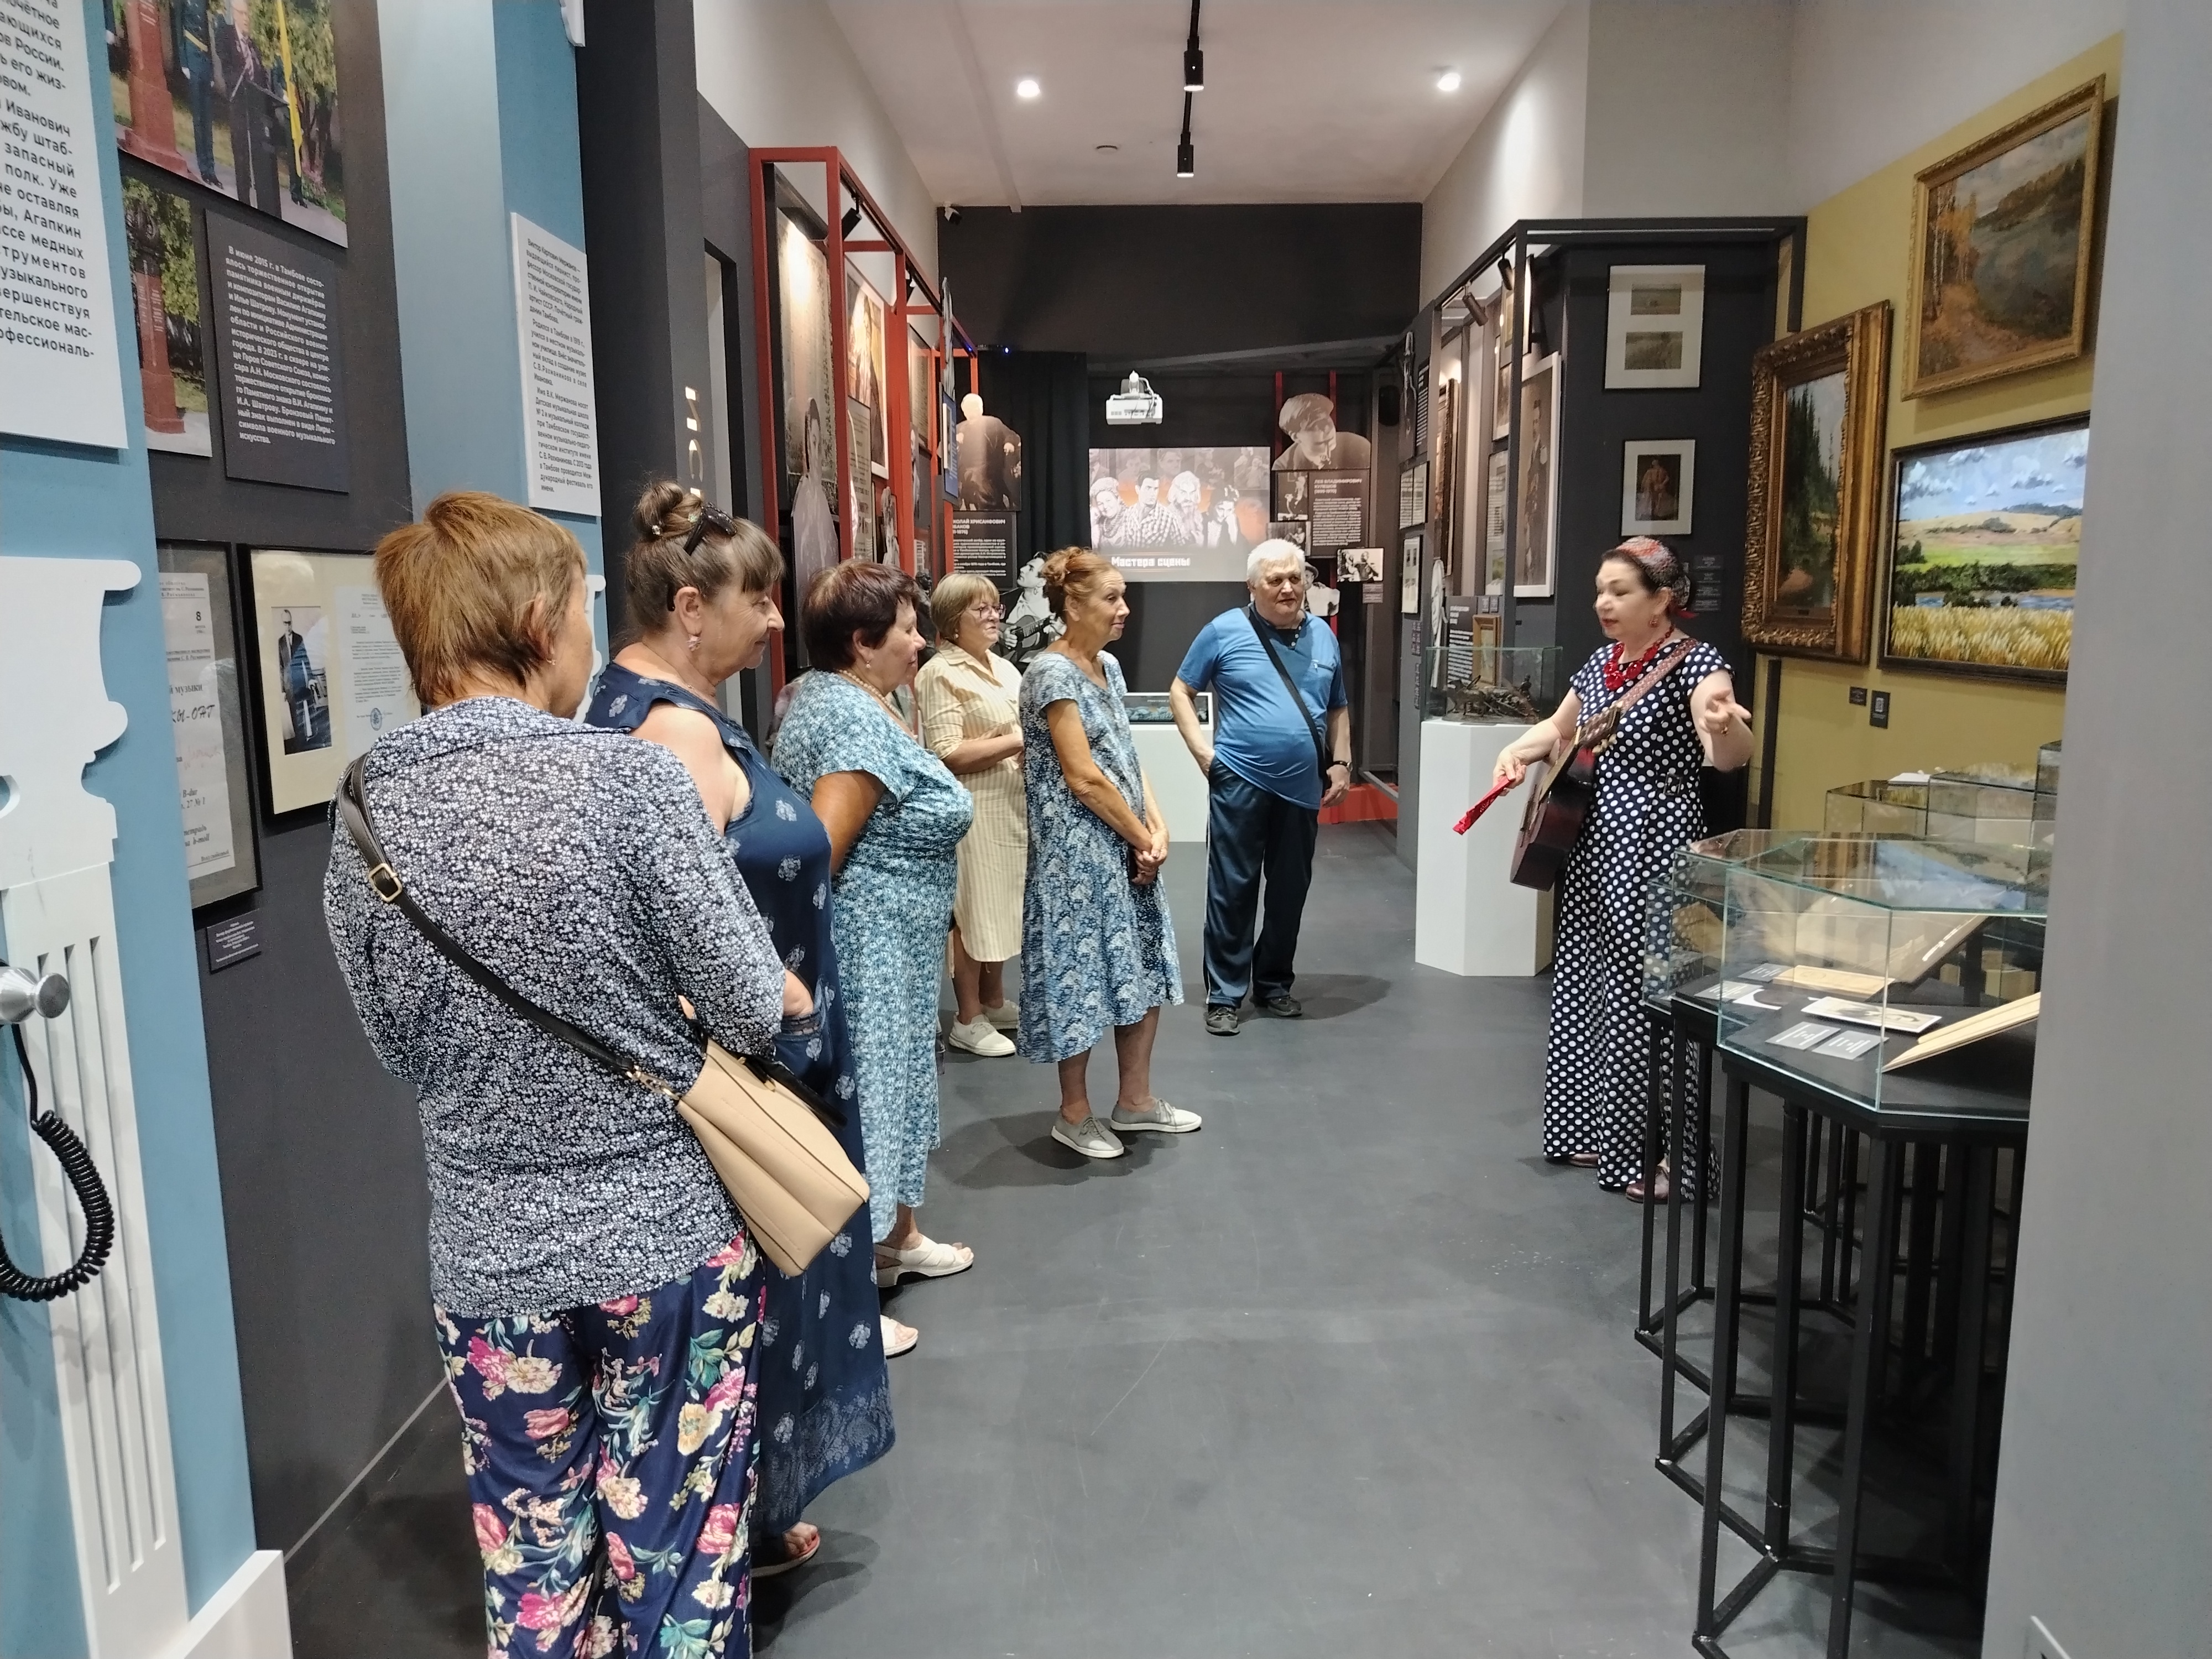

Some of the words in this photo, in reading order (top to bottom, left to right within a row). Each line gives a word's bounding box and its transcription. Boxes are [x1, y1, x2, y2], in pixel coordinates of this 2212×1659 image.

[15, 36, 64, 72] России.
[12, 59, 32, 76] его
[36, 69, 66, 90] жиз-
[6, 98, 70, 137] Иванович
[33, 133, 73, 155] штаб-
[5, 142, 74, 178] запасный
[5, 163, 44, 187] полк.
[50, 176, 77, 198] Уже
[17, 189, 80, 219] оставляя
[24, 209, 81, 239] Агапкин
[31, 233, 84, 260] медных
[226, 258, 246, 270] ялось
[247, 265, 295, 288] торжественное
[297, 284, 325, 299] открытие
[228, 246, 234, 254] В
[236, 250, 253, 262] июне
[254, 255, 268, 267] 2015
[280, 265, 305, 281] Тамбове
[306, 277, 324, 287] состо-
[227, 269, 262, 287] памятника
[264, 283, 291, 297] военным
[0, 288, 90, 320] ершенствуя
[233, 283, 275, 302] композиторам
[276, 296, 301, 311] Василию
[234, 293, 249, 305] Илье
[250, 299, 276, 315] Шатрову.
[277, 307, 305, 323] Монумент
[229, 305, 241, 314] лен
[251, 311, 285, 327] инициативе
[64, 323, 92, 339] мас-
[231, 316, 258, 330] области
[265, 326, 304, 343] Российского
[306, 340, 328, 351] военно-
[231, 328, 276, 347] исторического
[278, 341, 305, 354] общества
[232, 340, 256, 352] города.
[263, 347, 277, 358] 2023
[289, 356, 309, 367] сквере
[242, 352, 260, 364] Героя
[260, 358, 293, 372] Советского
[234, 363, 249, 373] сара
[250, 366, 263, 375] А.Н.
[263, 369, 300, 385] Московского
[234, 375, 279, 390] торжественное
[280, 386, 306, 397] открытие
[237, 397, 251, 406] И.А.
[252, 400, 280, 414] Шатрову.
[281, 406, 314, 420] Бронзовый
[315, 413, 333, 424] Памят-
[244, 387, 275, 400] Памятного
[275, 395, 291, 404] знака
[293, 398, 303, 407] В.И.
[238, 409, 251, 418] ный
[251, 412, 265, 421] знак
[267, 415, 295, 426] выполнен
[301, 422, 315, 431] виде
[316, 424, 331, 434] Лиры
[238, 421, 266, 431] символа
[267, 426, 295, 437] военного
[296, 432, 335, 445] музыкального
[1111, 556, 1155, 568] Мастера
[1157, 557, 1191, 567] сцены
[196, 611, 201, 621] 8
[175, 684, 203, 696] музыки
[182, 788, 197, 798] B-dur
